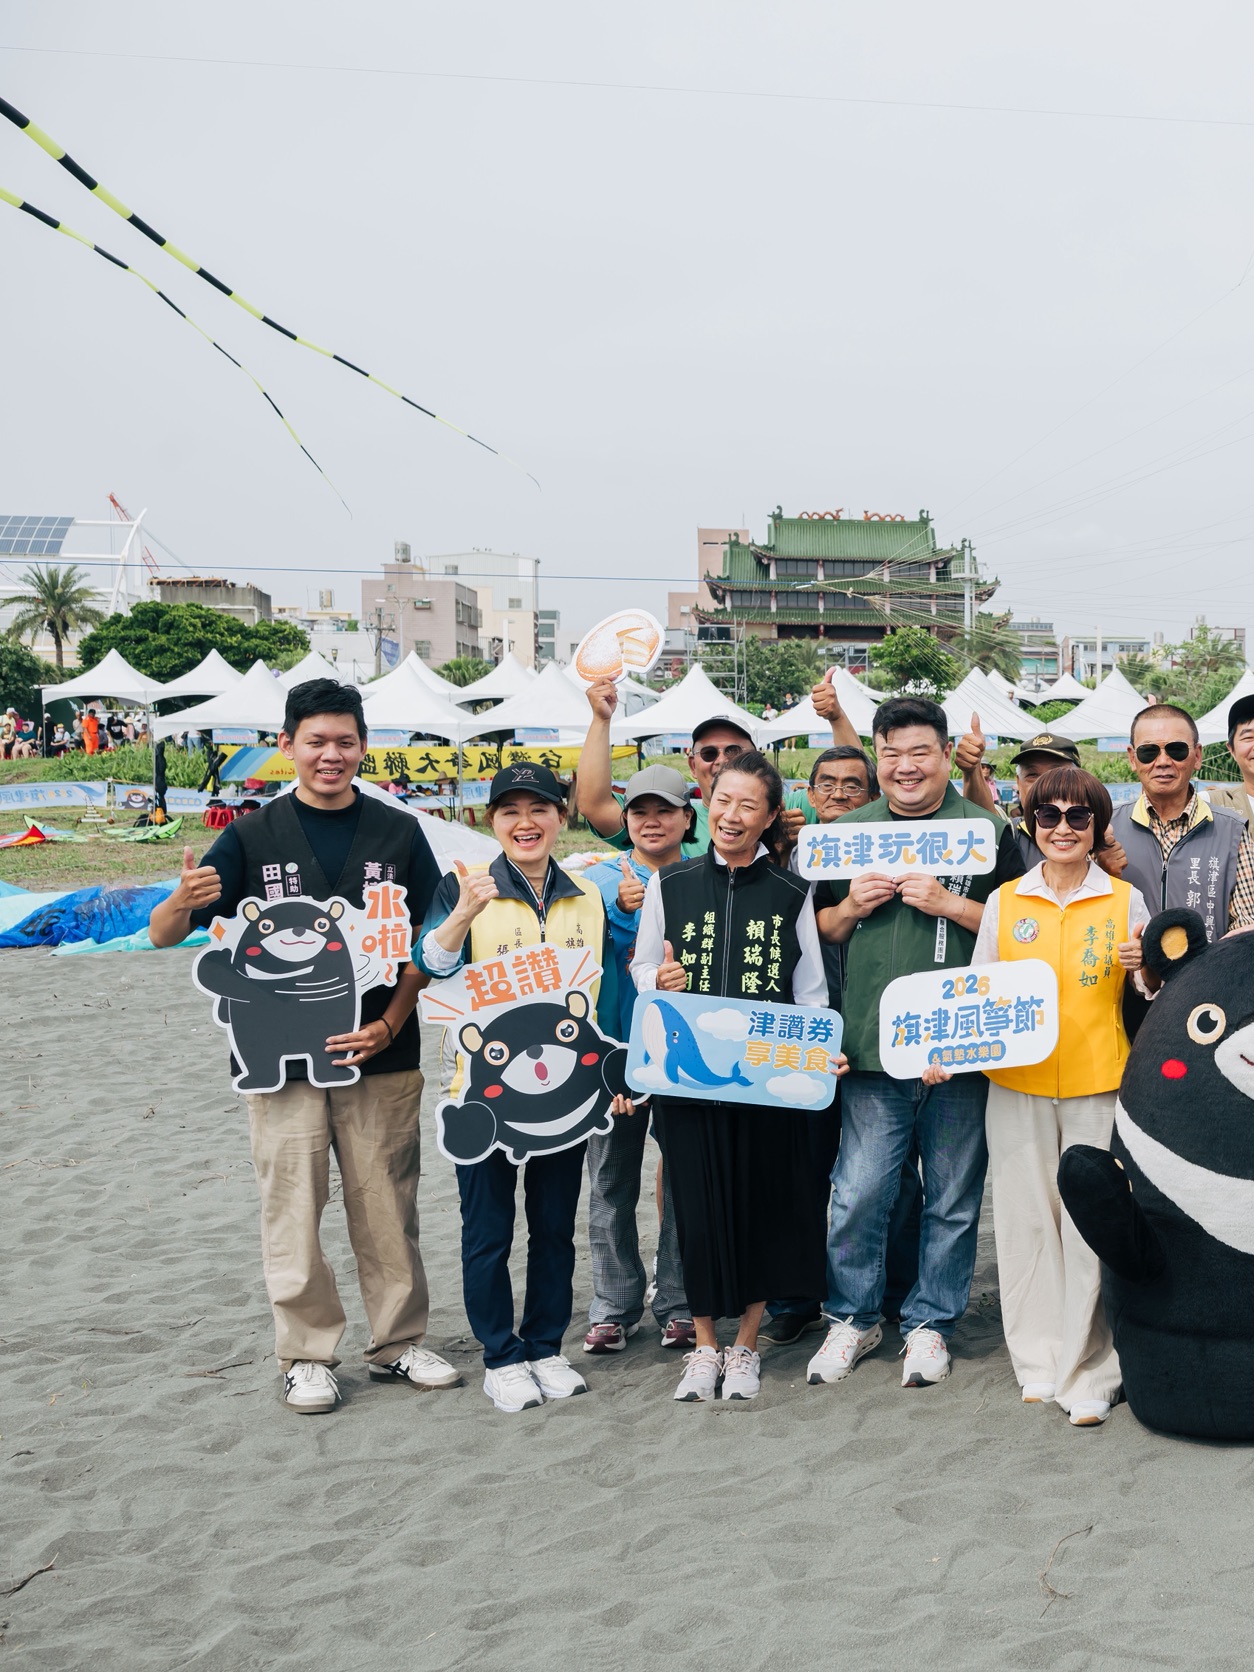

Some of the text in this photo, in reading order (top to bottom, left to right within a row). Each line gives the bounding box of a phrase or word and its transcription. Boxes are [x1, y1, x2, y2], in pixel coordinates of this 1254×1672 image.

[806, 829, 988, 869] 旗津玩很大
[288, 876, 299, 893] 特助
[1185, 857, 1201, 909] 里長 郭
[1204, 855, 1220, 943] 旗津區中興里
[514, 927, 524, 949] 區長
[699, 911, 716, 993] 組織群副主任
[741, 919, 765, 994] 賴瑞隆
[765, 914, 784, 993] 市長候選人
[1079, 925, 1101, 988] 李喬如
[1103, 918, 1116, 979] 高雄市議員
[463, 946, 563, 1012] 超讚
[942, 974, 990, 1000] 2026
[891, 995, 1045, 1048] 旗津風箏節
[743, 1039, 832, 1075] 享美食
